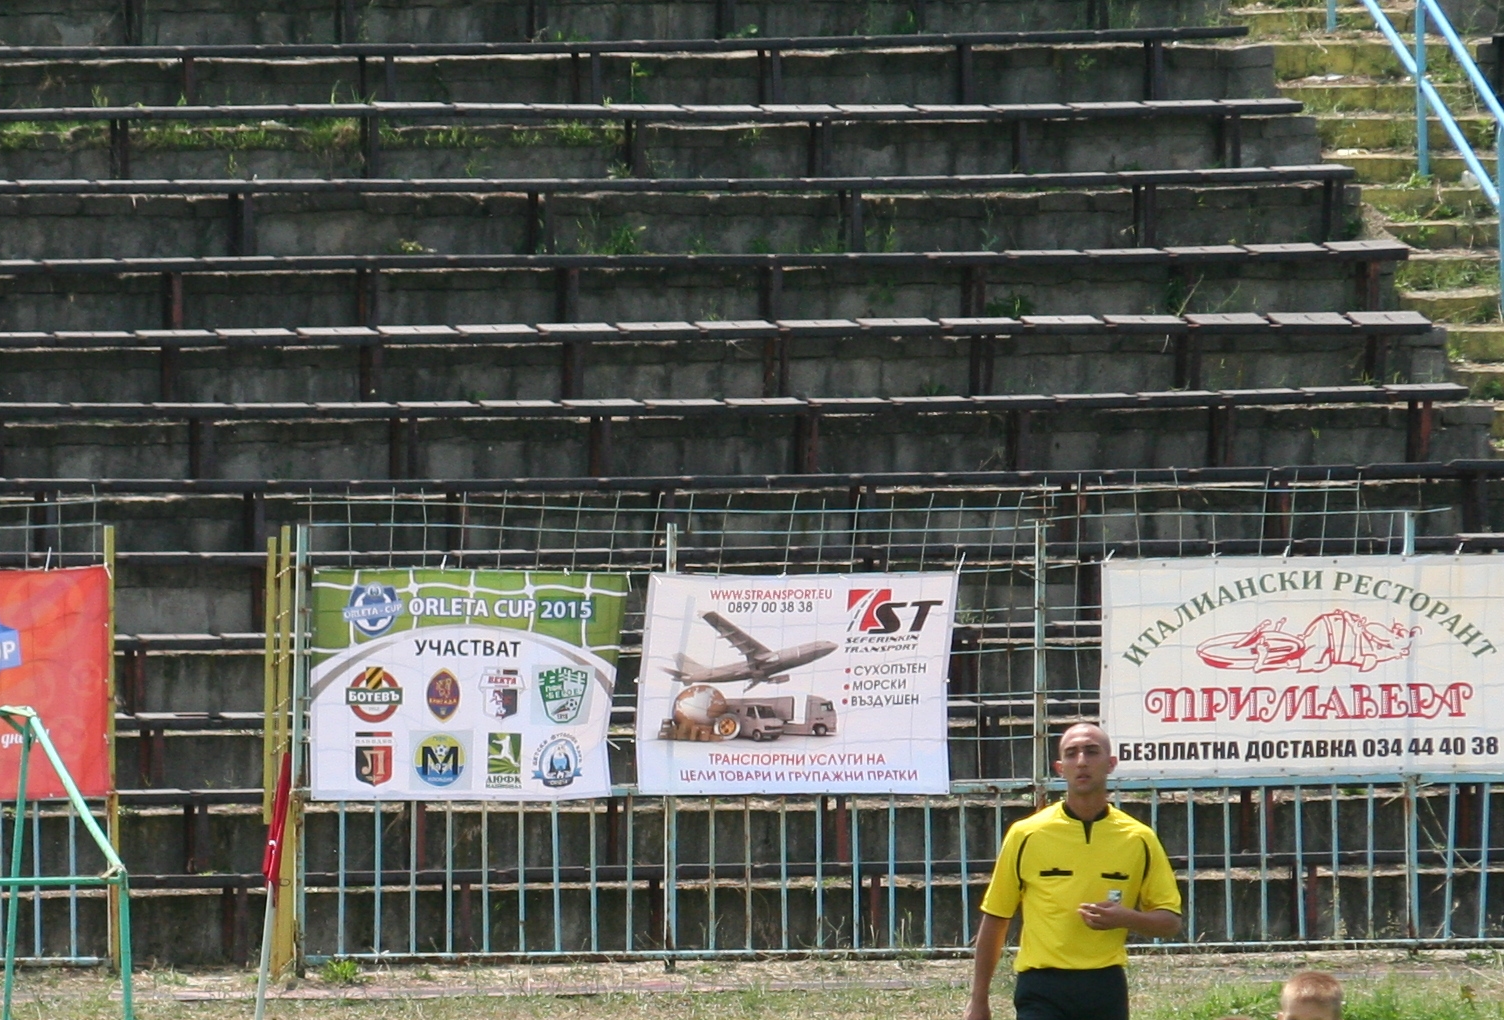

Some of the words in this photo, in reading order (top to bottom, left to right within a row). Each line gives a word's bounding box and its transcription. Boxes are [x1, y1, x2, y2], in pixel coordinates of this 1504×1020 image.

[710, 589, 833, 600] WWW.STRANSPORT.EU
[408, 598, 489, 617] ORLETA
[494, 598, 536, 618] CUP
[540, 601, 592, 619] 2015
[728, 602, 758, 613] 0897
[761, 602, 777, 613] 00
[780, 602, 794, 613] 38
[798, 601, 813, 612] 38
[1122, 570, 1323, 667] ИТАЛИАНСКИ
[1333, 570, 1498, 659] РЕСТОРАНТ
[414, 640, 521, 658] УЧАСТВАТ
[844, 643, 918, 653] TRANSPORT
[854, 663, 927, 676] СУХОПЪТЕН
[852, 679, 907, 691] МОРСКИ
[349, 691, 400, 702] БОТЕВЪ
[851, 694, 919, 707] ВЪЗДУШЕН
[1144, 682, 1474, 723] ПРИМАВЕРА
[1119, 740, 1240, 762] БЕЗПЛАТНА
[1245, 738, 1357, 763] ДОСТАВКА
[1362, 738, 1403, 758] 034
[1408, 737, 1434, 757] 44
[1439, 737, 1465, 756] 40
[1471, 736, 1499, 756] 38
[709, 753, 805, 766] ТРАНСПОРТНИ
[809, 753, 862, 766] УСЛУГИ
[867, 753, 886, 765] НА
[680, 769, 716, 783] ЦЕЛИ
[719, 770, 772, 782] ТОВАРИ
[775, 771, 784, 782] И
[789, 770, 864, 782] ГРУПАЖНИ
[867, 769, 918, 782] ПРАТКИ
